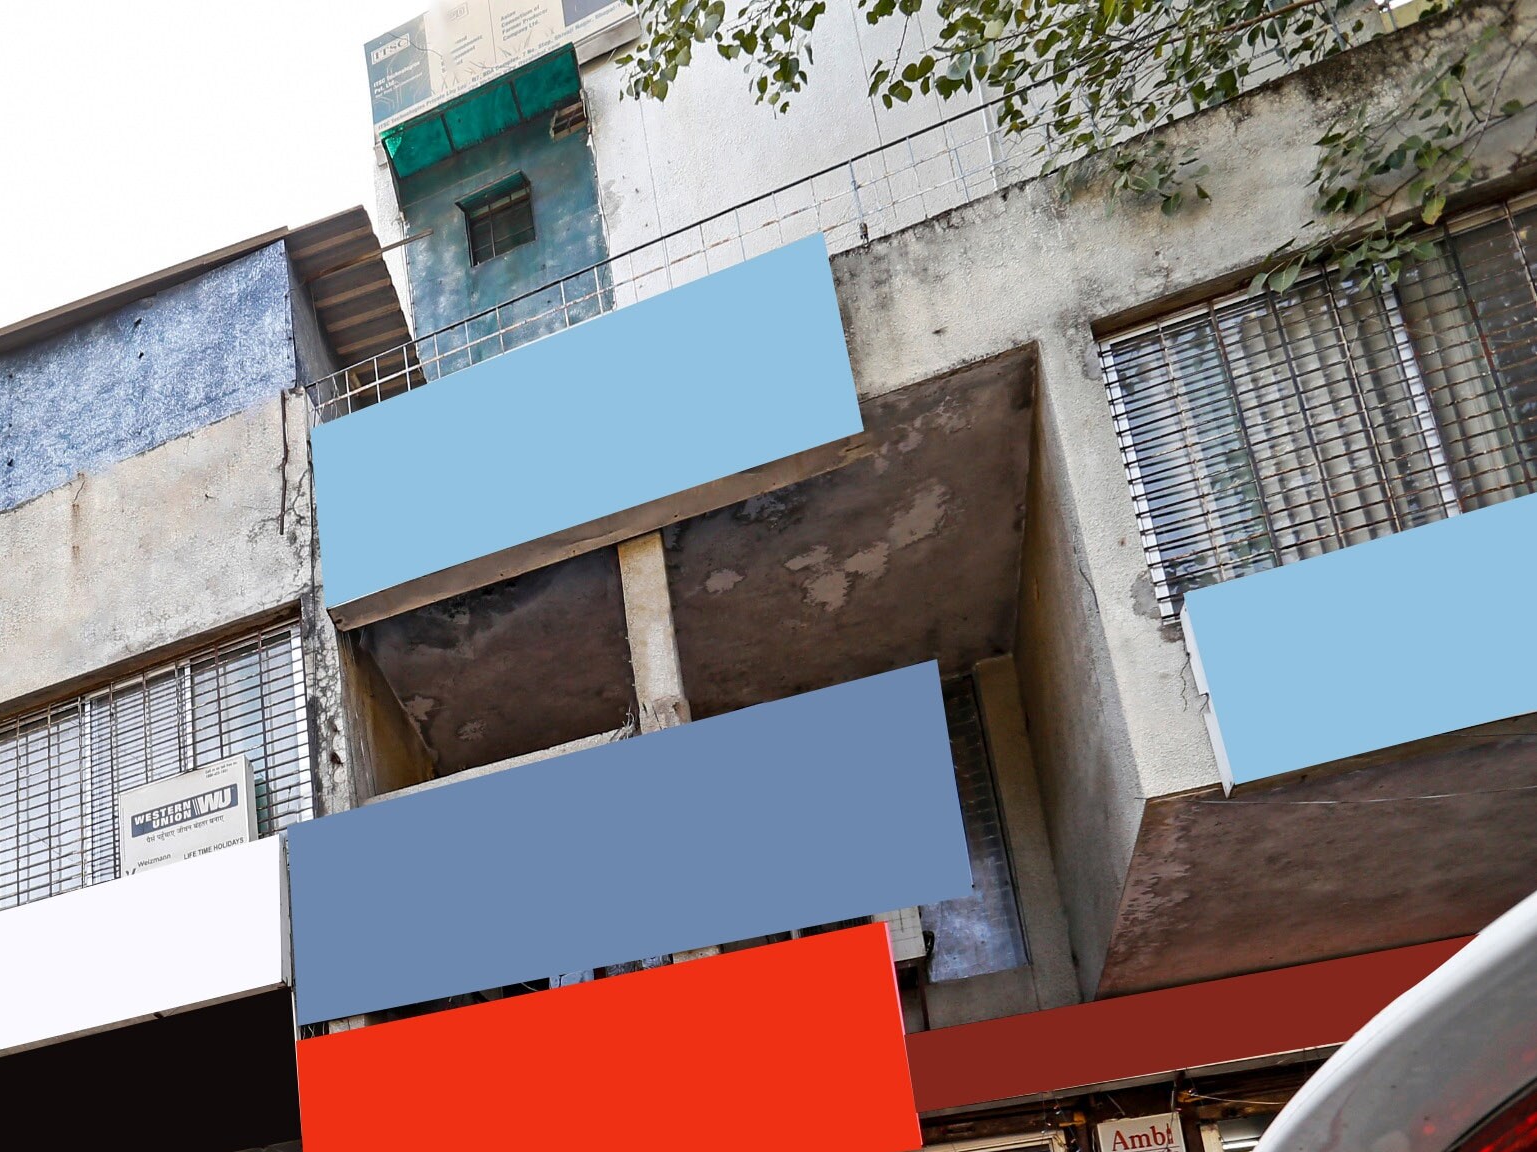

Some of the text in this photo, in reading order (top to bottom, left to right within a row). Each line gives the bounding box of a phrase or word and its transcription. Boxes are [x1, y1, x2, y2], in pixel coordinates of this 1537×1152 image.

[134, 787, 232, 826] WESTERN WU
[152, 810, 192, 829] UNION
[137, 836, 244, 868] Weizmann LIFE TIME HOLIDAYS
[1111, 1122, 1174, 1151] Ambi
